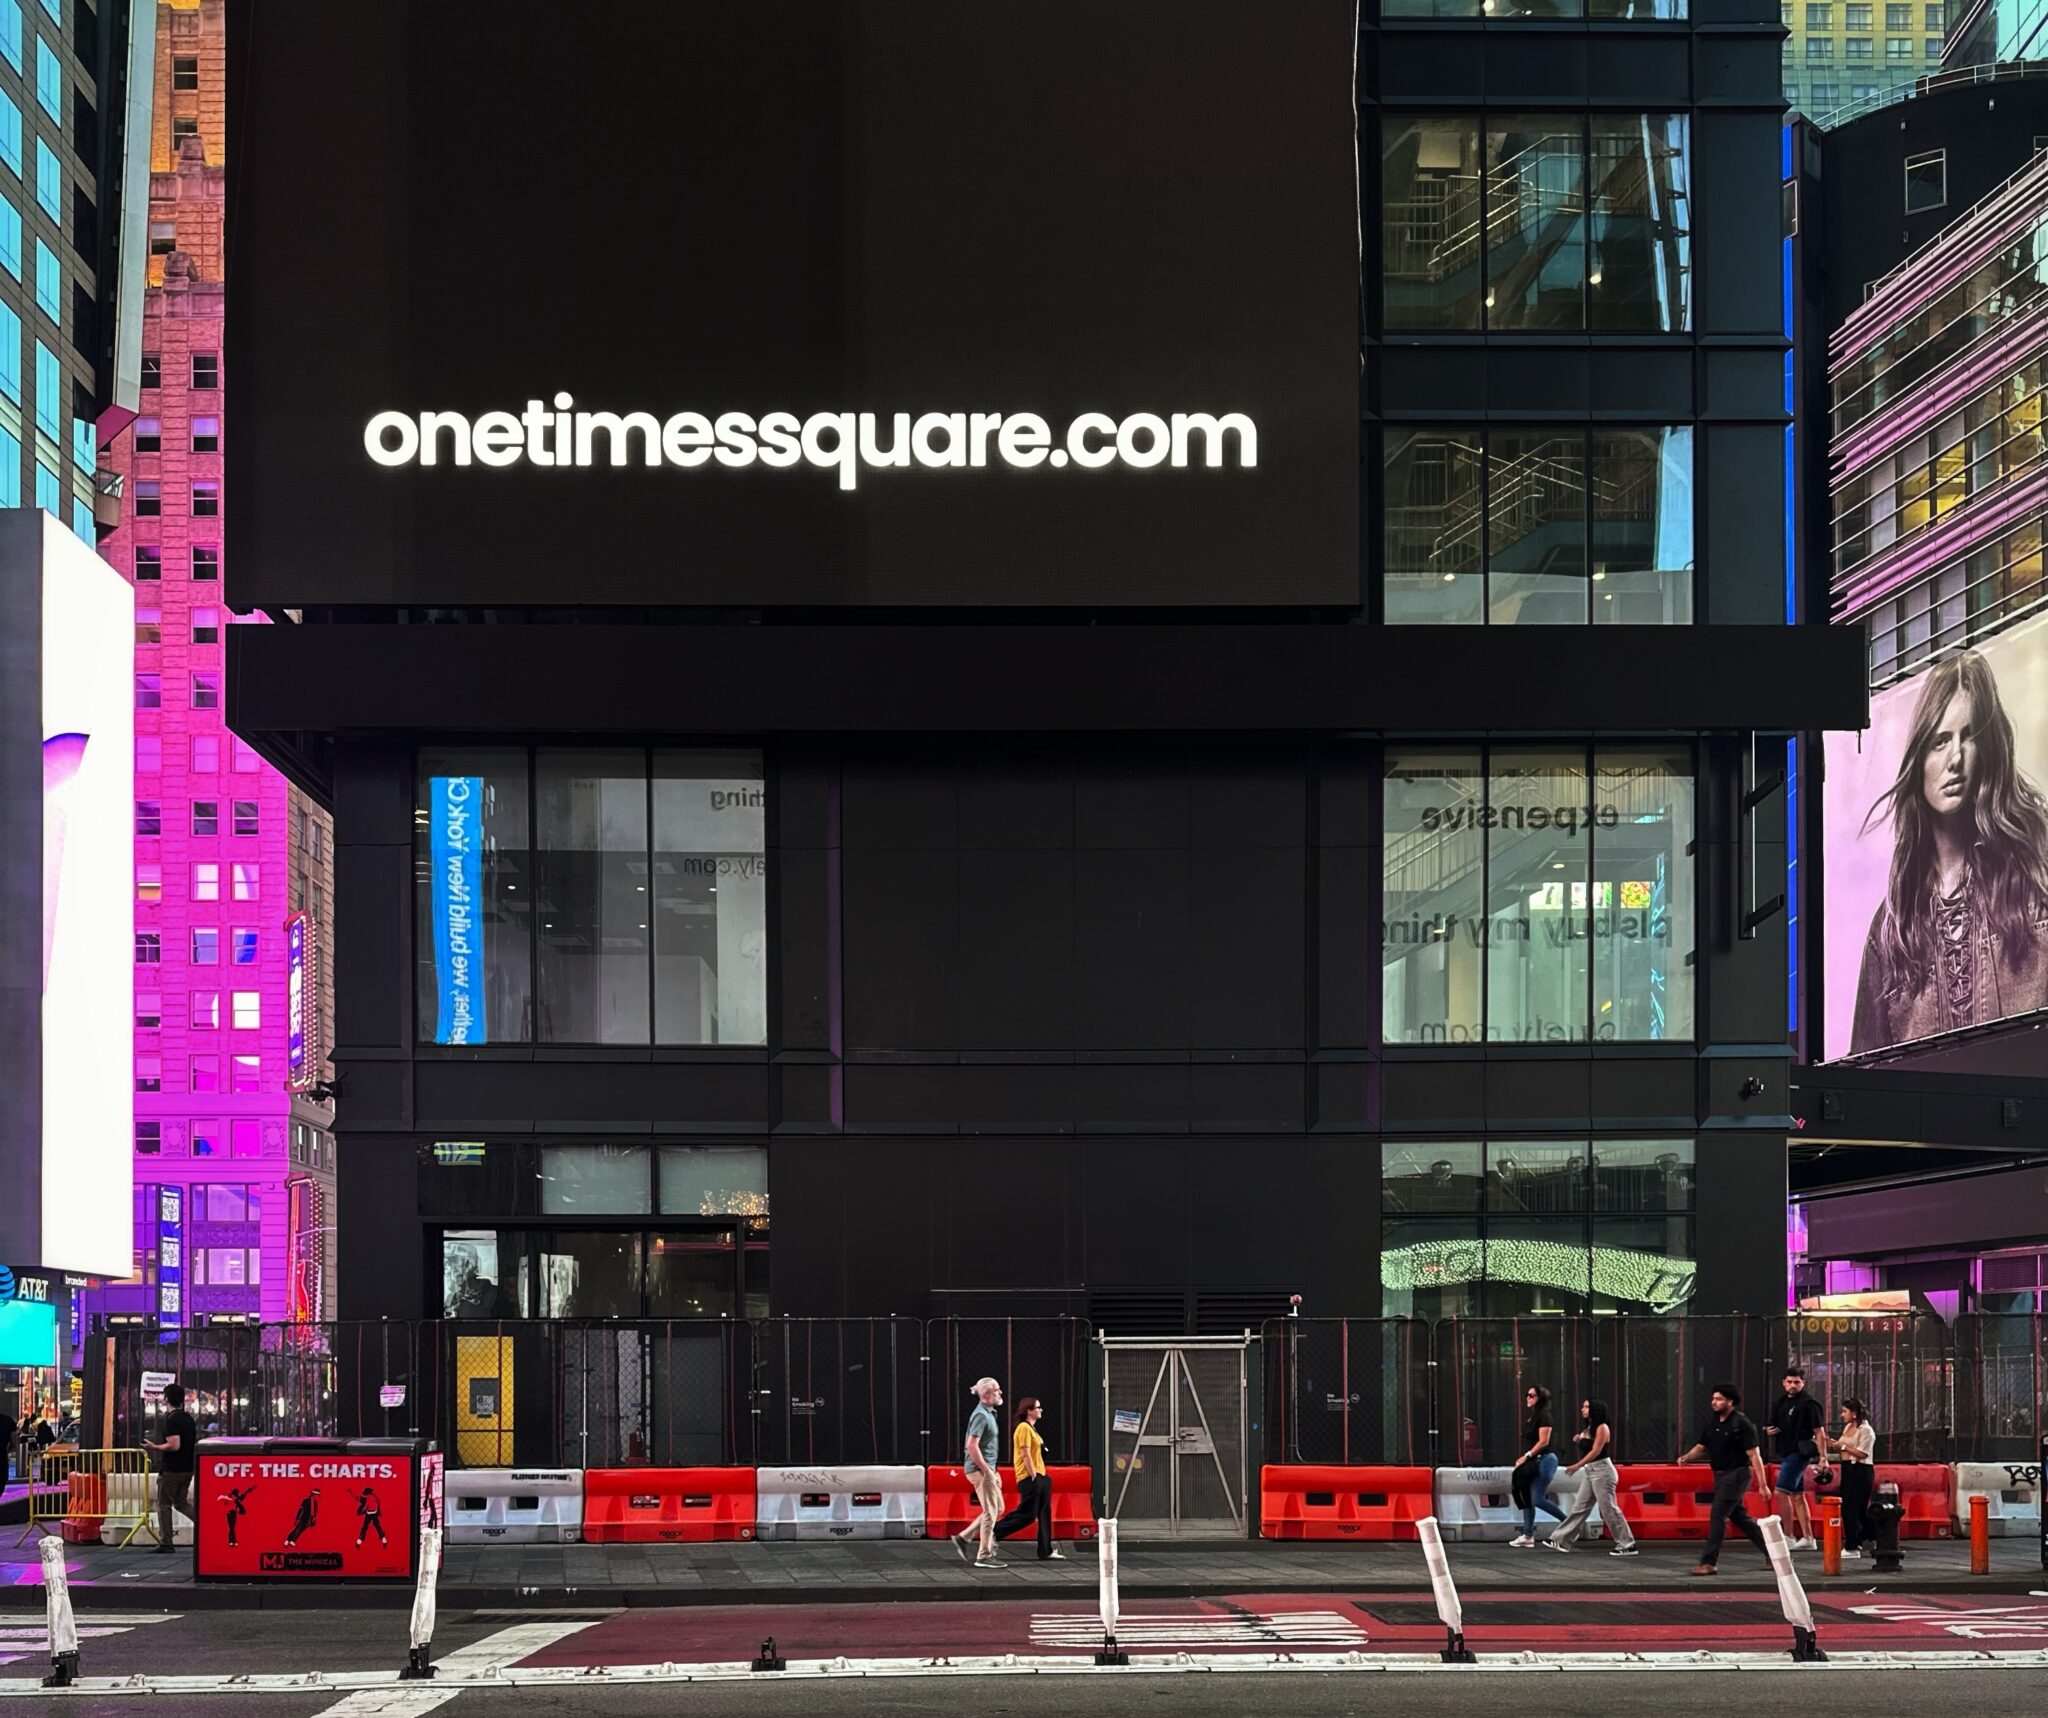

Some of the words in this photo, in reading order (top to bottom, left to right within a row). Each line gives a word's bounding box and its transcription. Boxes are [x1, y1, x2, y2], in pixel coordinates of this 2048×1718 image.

[364, 391, 1259, 491] onetimessquare.com
[18, 1277, 49, 1302] AT&T
[214, 1463, 254, 1478] OFF.
[259, 1463, 305, 1478] THE.
[309, 1463, 397, 1479] CHARTS.
[263, 1554, 285, 1569] MJ
